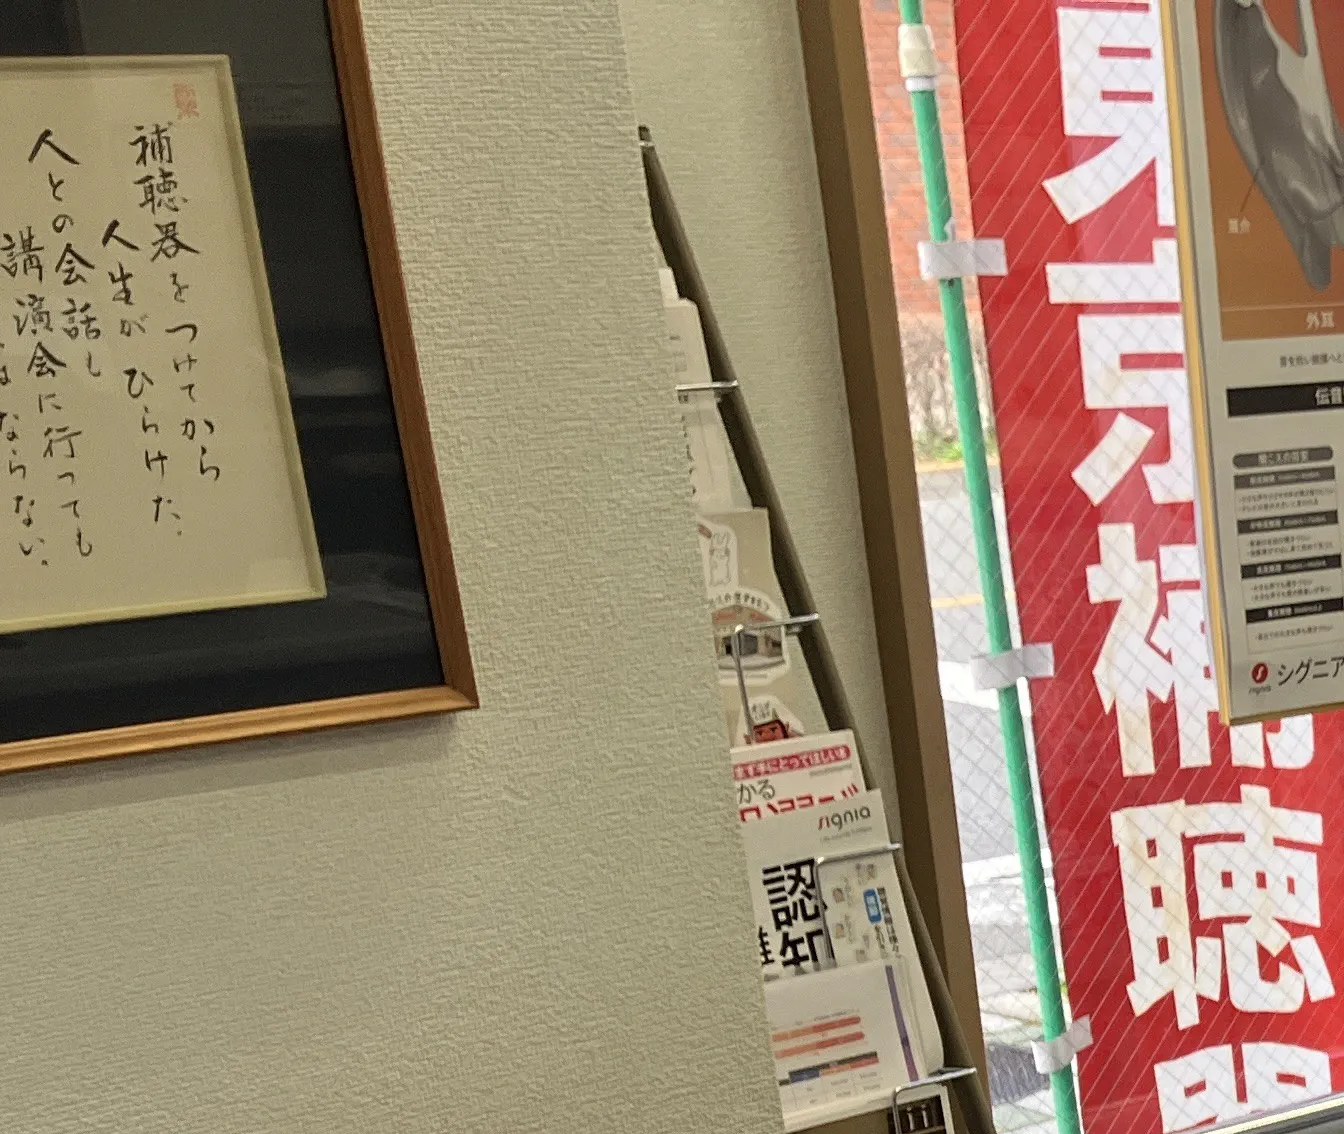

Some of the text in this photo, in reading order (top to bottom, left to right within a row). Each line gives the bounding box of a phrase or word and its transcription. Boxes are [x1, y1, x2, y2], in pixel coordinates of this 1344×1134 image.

[102, 219, 183, 537] 人生がひらけた。
[128, 121, 221, 482] 補聴器をつけてから
[817, 805, 872, 831] signia
